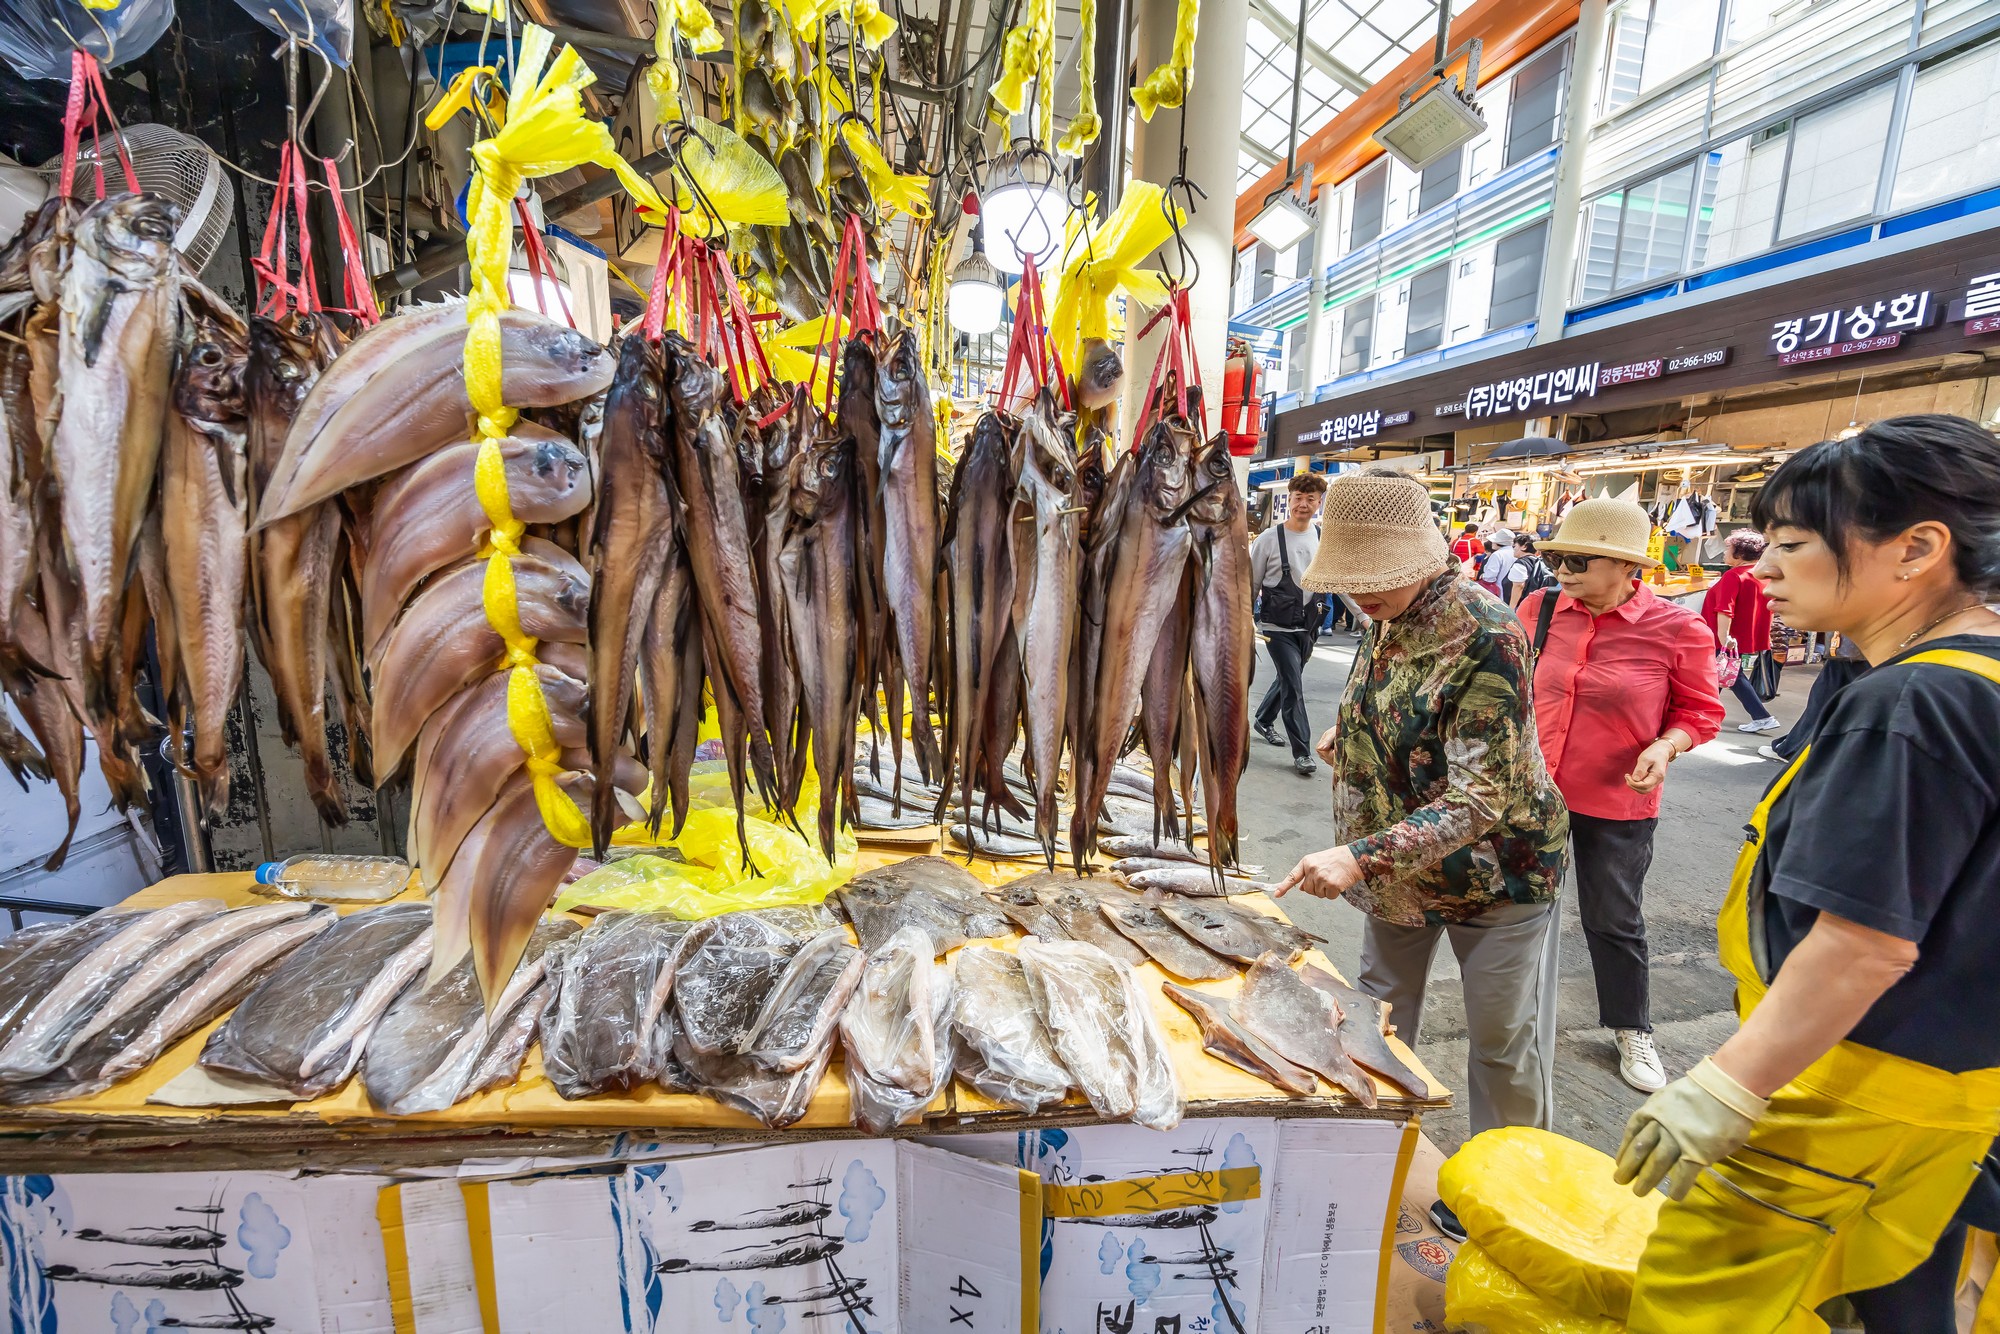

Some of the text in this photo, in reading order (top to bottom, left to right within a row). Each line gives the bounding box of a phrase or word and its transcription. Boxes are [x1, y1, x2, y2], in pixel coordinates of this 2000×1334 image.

[1772, 290, 1930, 354] 경기상회
[1669, 350, 1723, 371] 02-966-1950
[1783, 335, 1897, 363] 국산약초도매 02-967-9913
[1600, 359, 1661, 385] 경동직판장
[1465, 362, 1600, 420] (주)한영디엔씨
[1326, 1202, 1338, 1230] 냉동보관
[950, 1275, 982, 1298] 4
